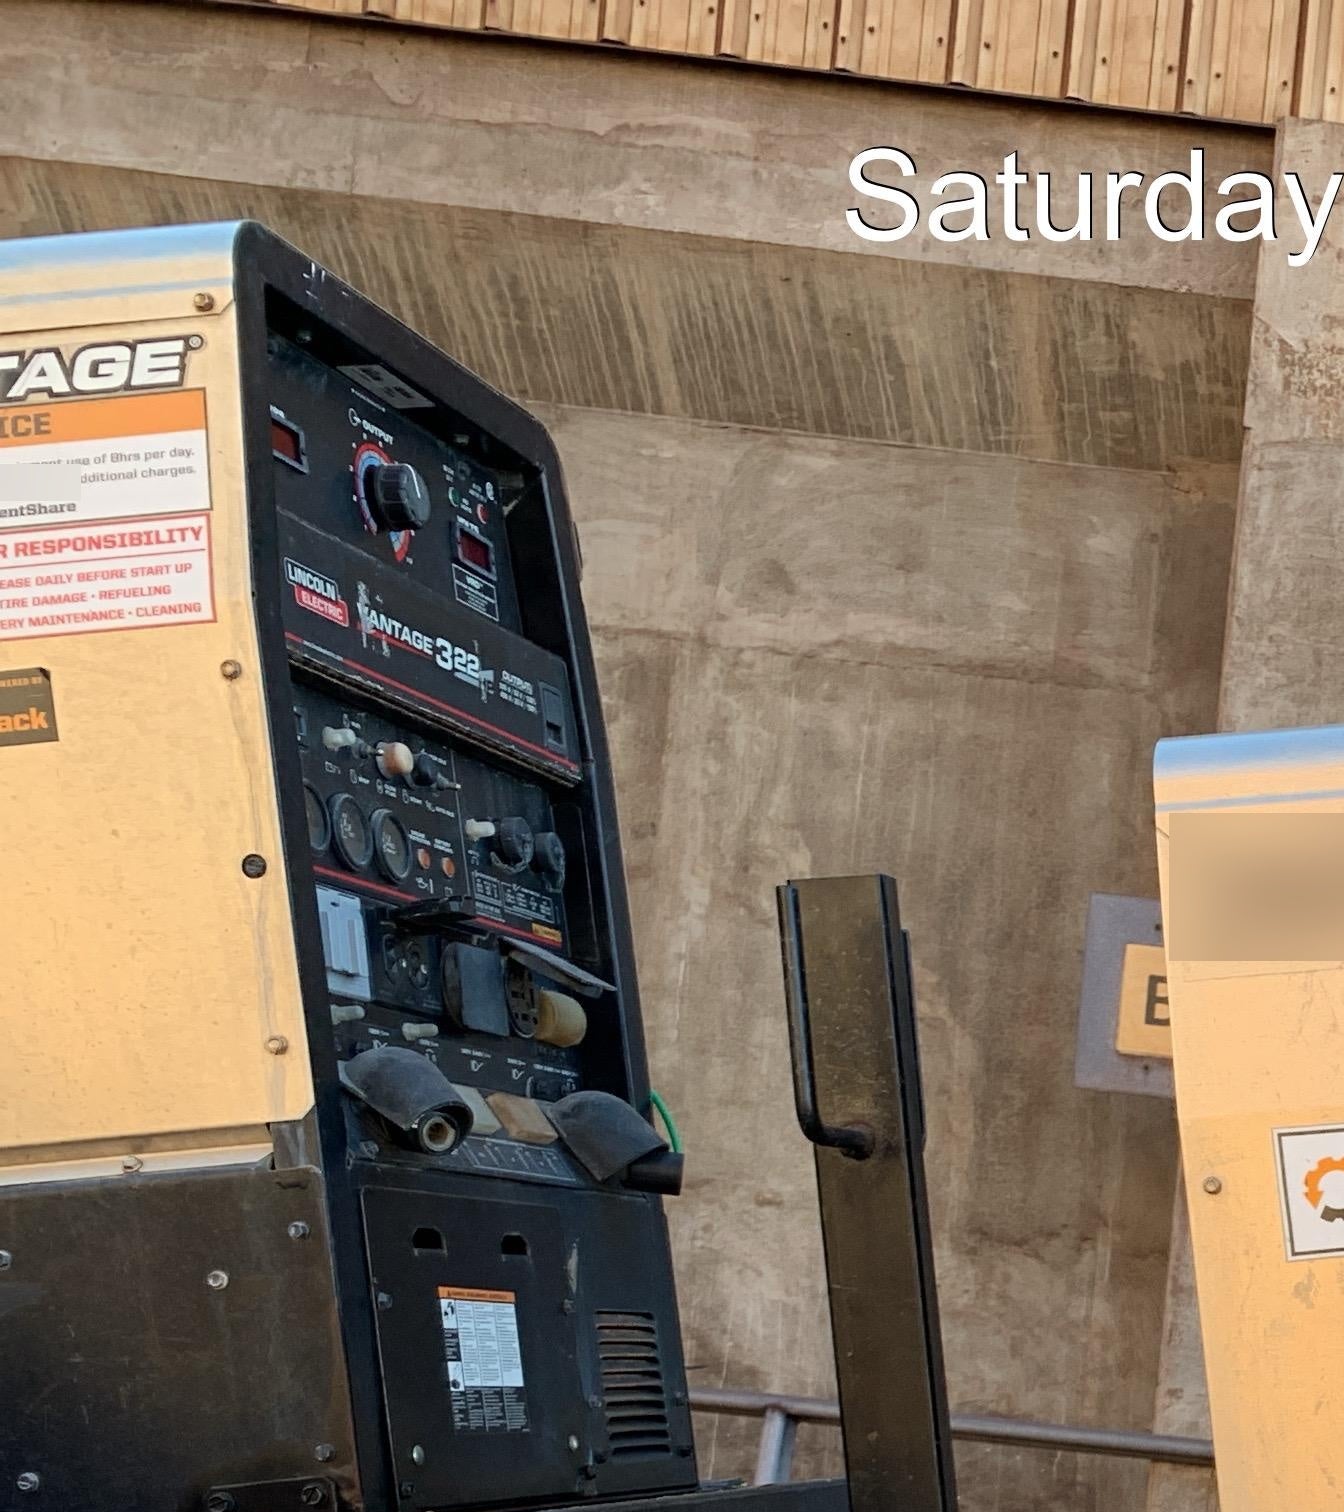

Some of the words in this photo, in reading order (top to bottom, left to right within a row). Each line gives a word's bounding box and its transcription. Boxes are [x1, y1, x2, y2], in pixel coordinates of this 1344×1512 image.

[94, 453, 107, 464] of
[144, 449, 165, 462] per
[169, 446, 195, 458] day.
[80, 468, 138, 484] dditional
[141, 464, 196, 478] charges.
[14, 525, 203, 558] RESPONSIBILITY
[35, 573, 73, 586] DAILY
[77, 568, 127, 582] BEFORE
[130, 564, 172, 578] START
[175, 562, 192, 574] UP
[286, 563, 337, 602] LINCOLN
[32, 592, 88, 607] DAMAGE
[98, 585, 172, 601] REFUELING
[300, 590, 344, 621] ELECTRIC
[28, 608, 126, 627] MAINTENANCE
[136, 602, 202, 618] CLEANING
[435, 637, 480, 676] 322
